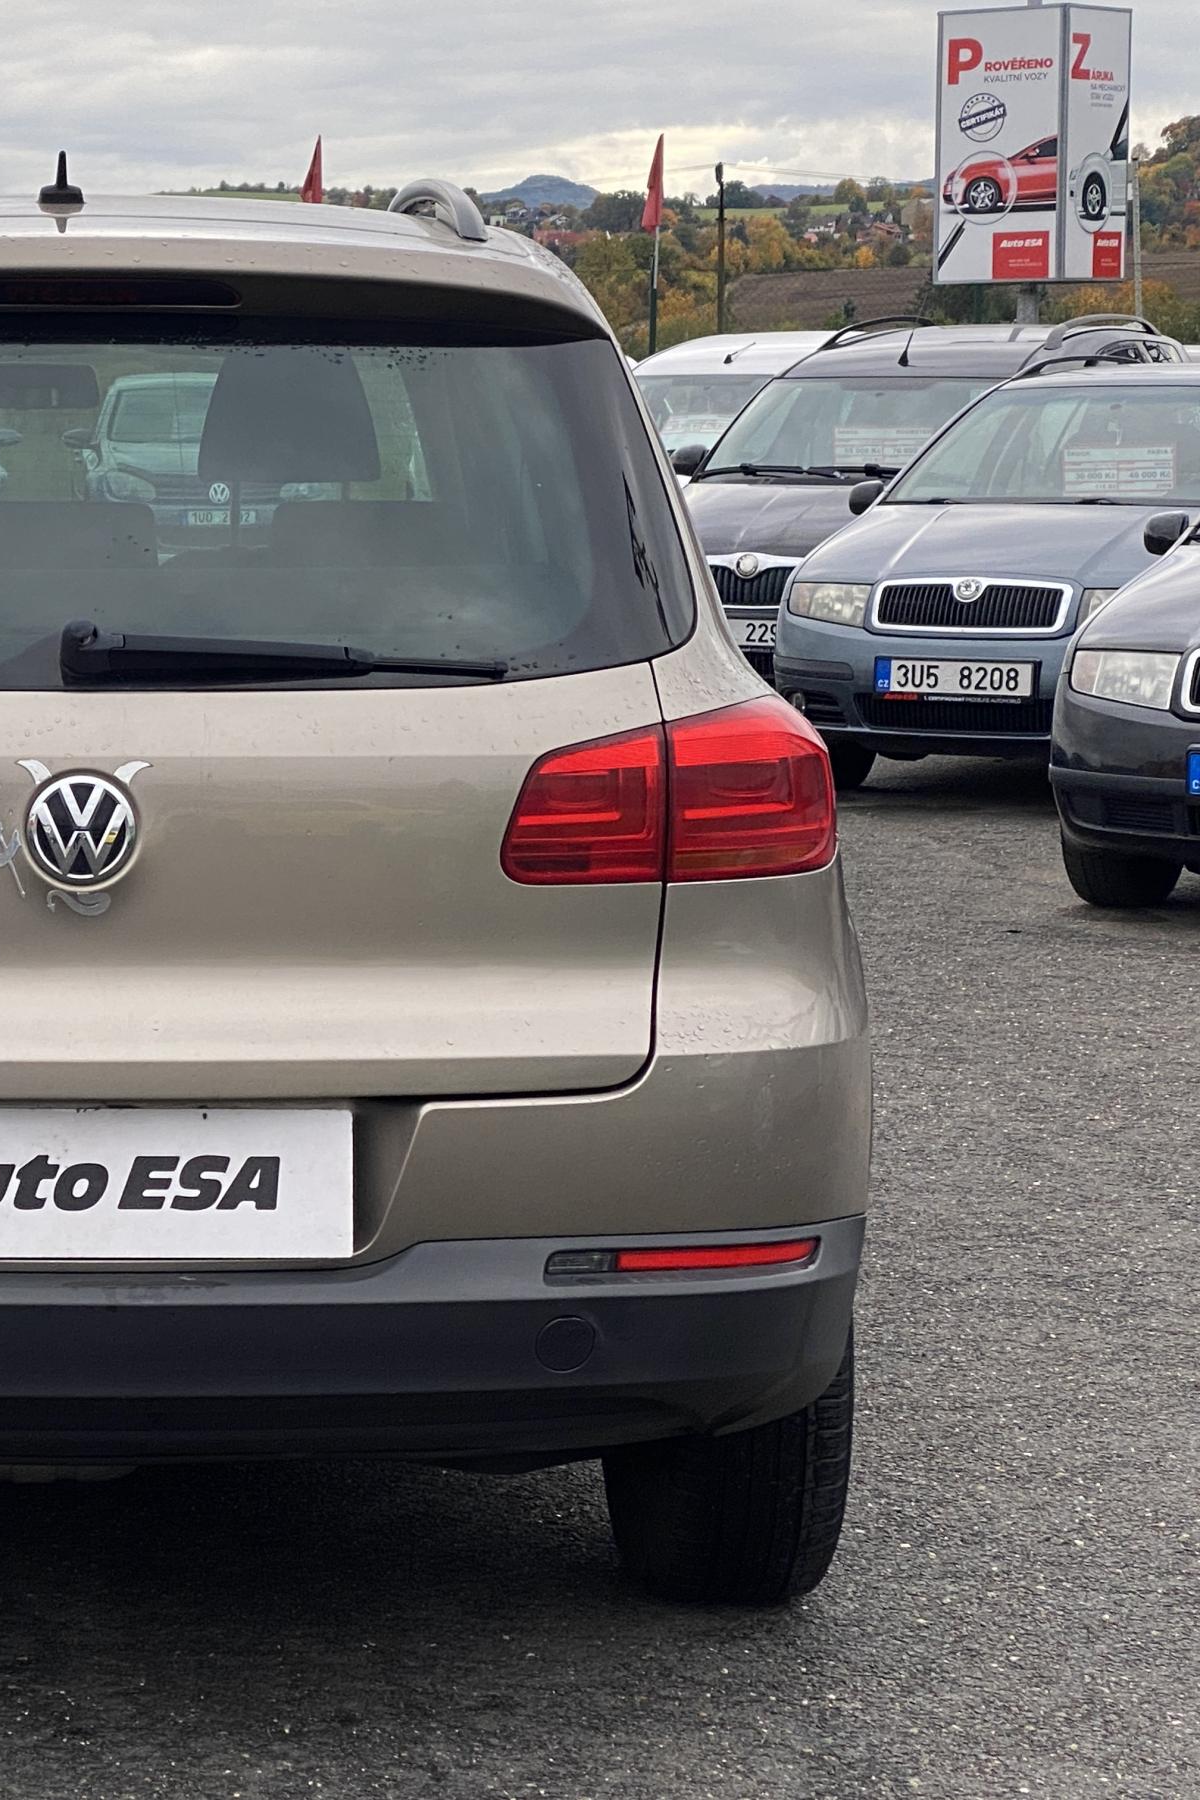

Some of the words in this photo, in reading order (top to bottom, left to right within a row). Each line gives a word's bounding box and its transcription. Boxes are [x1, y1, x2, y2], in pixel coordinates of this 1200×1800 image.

[984, 72, 1022, 83] KVALITNÍ
[1025, 72, 1048, 80] VOZY
[961, 106, 1004, 128] CERTIFIKÁT
[1000, 239, 1023, 248] Auto
[1025, 239, 1043, 247] ESA
[877, 679, 889, 688] CZ
[897, 664, 939, 689] 3U5
[959, 666, 1019, 692] 8208
[1192, 779, 1200, 790] C
[117, 1155, 280, 1211] ESA
